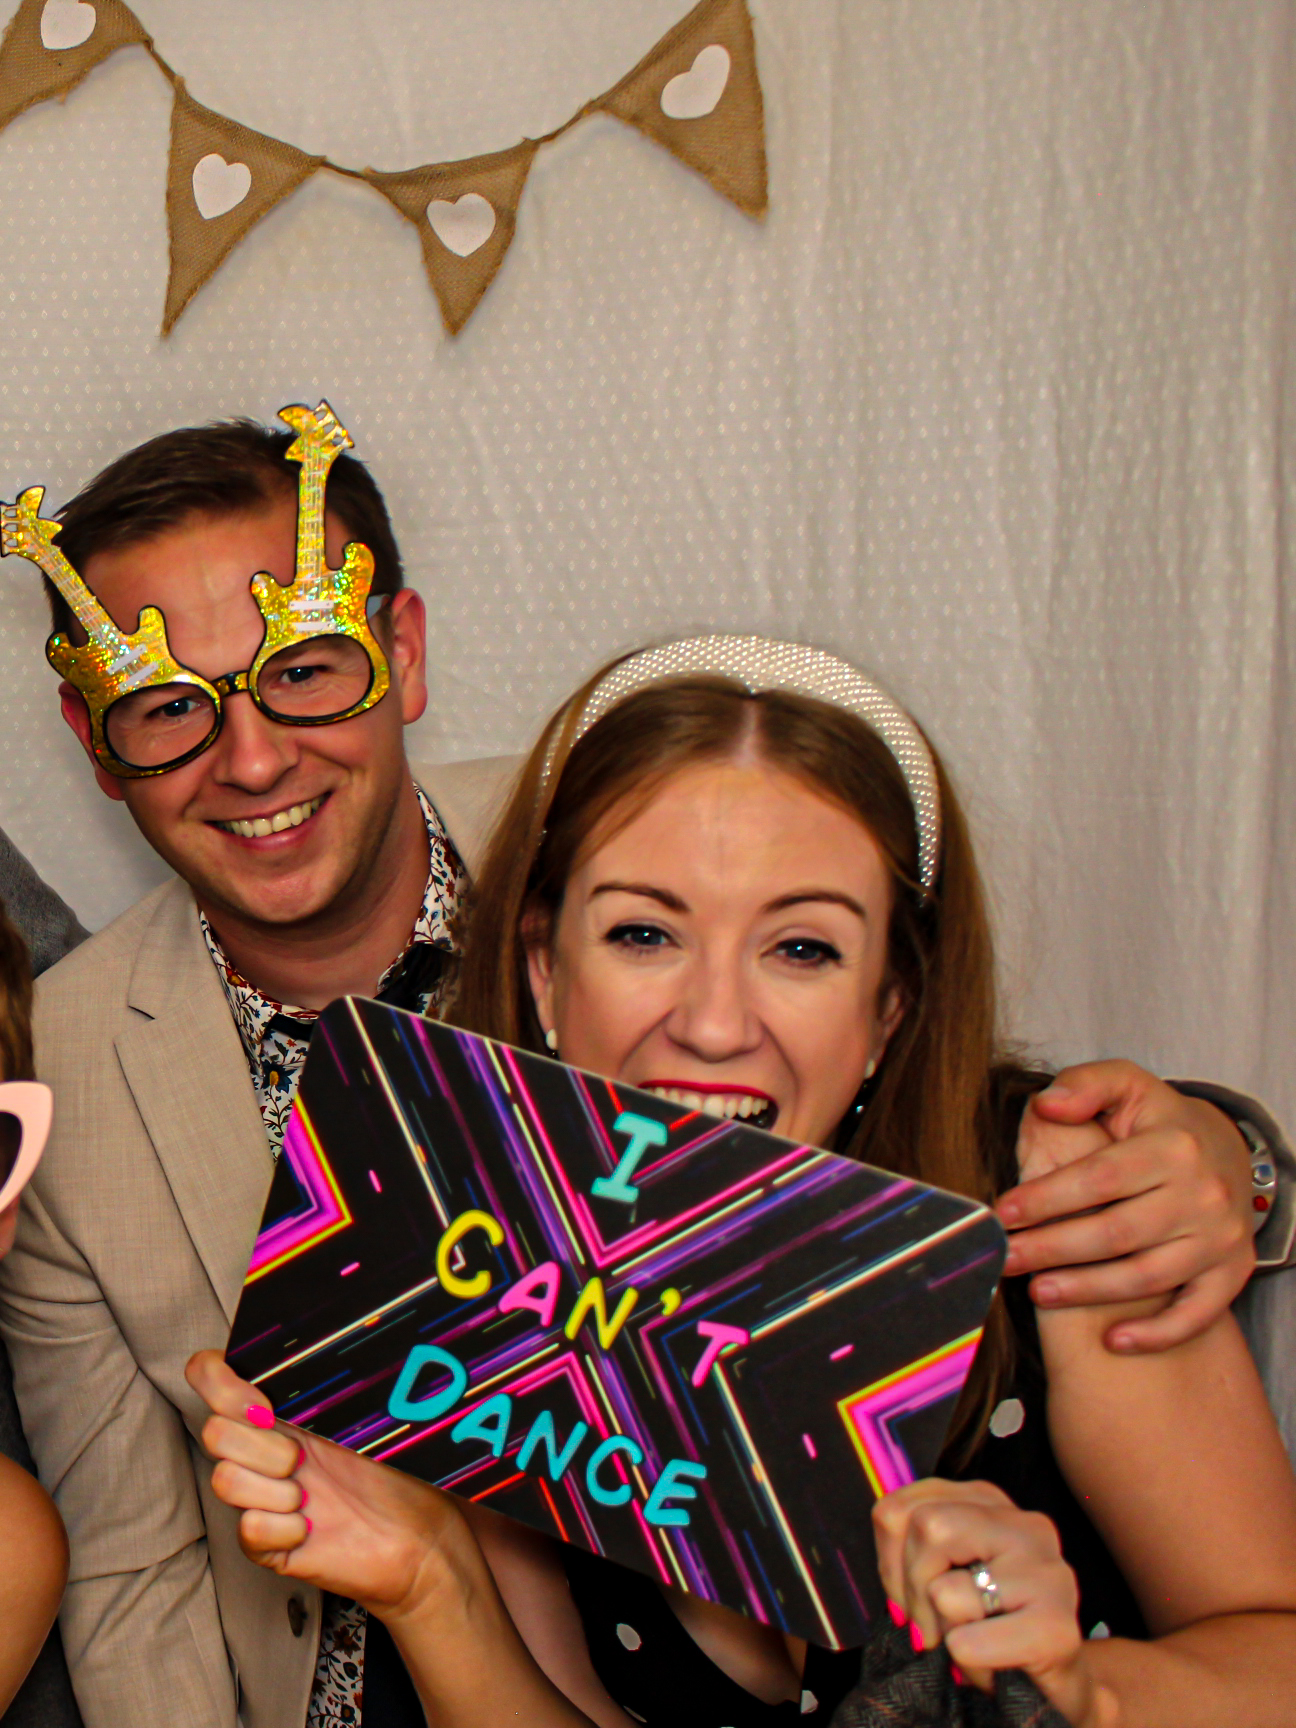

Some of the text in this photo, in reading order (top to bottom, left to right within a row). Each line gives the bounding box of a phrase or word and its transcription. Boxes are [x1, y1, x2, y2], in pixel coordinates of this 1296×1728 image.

[591, 1111, 668, 1203] I
[436, 1210, 750, 1387] CAN'T
[388, 1344, 707, 1526] DANCE
